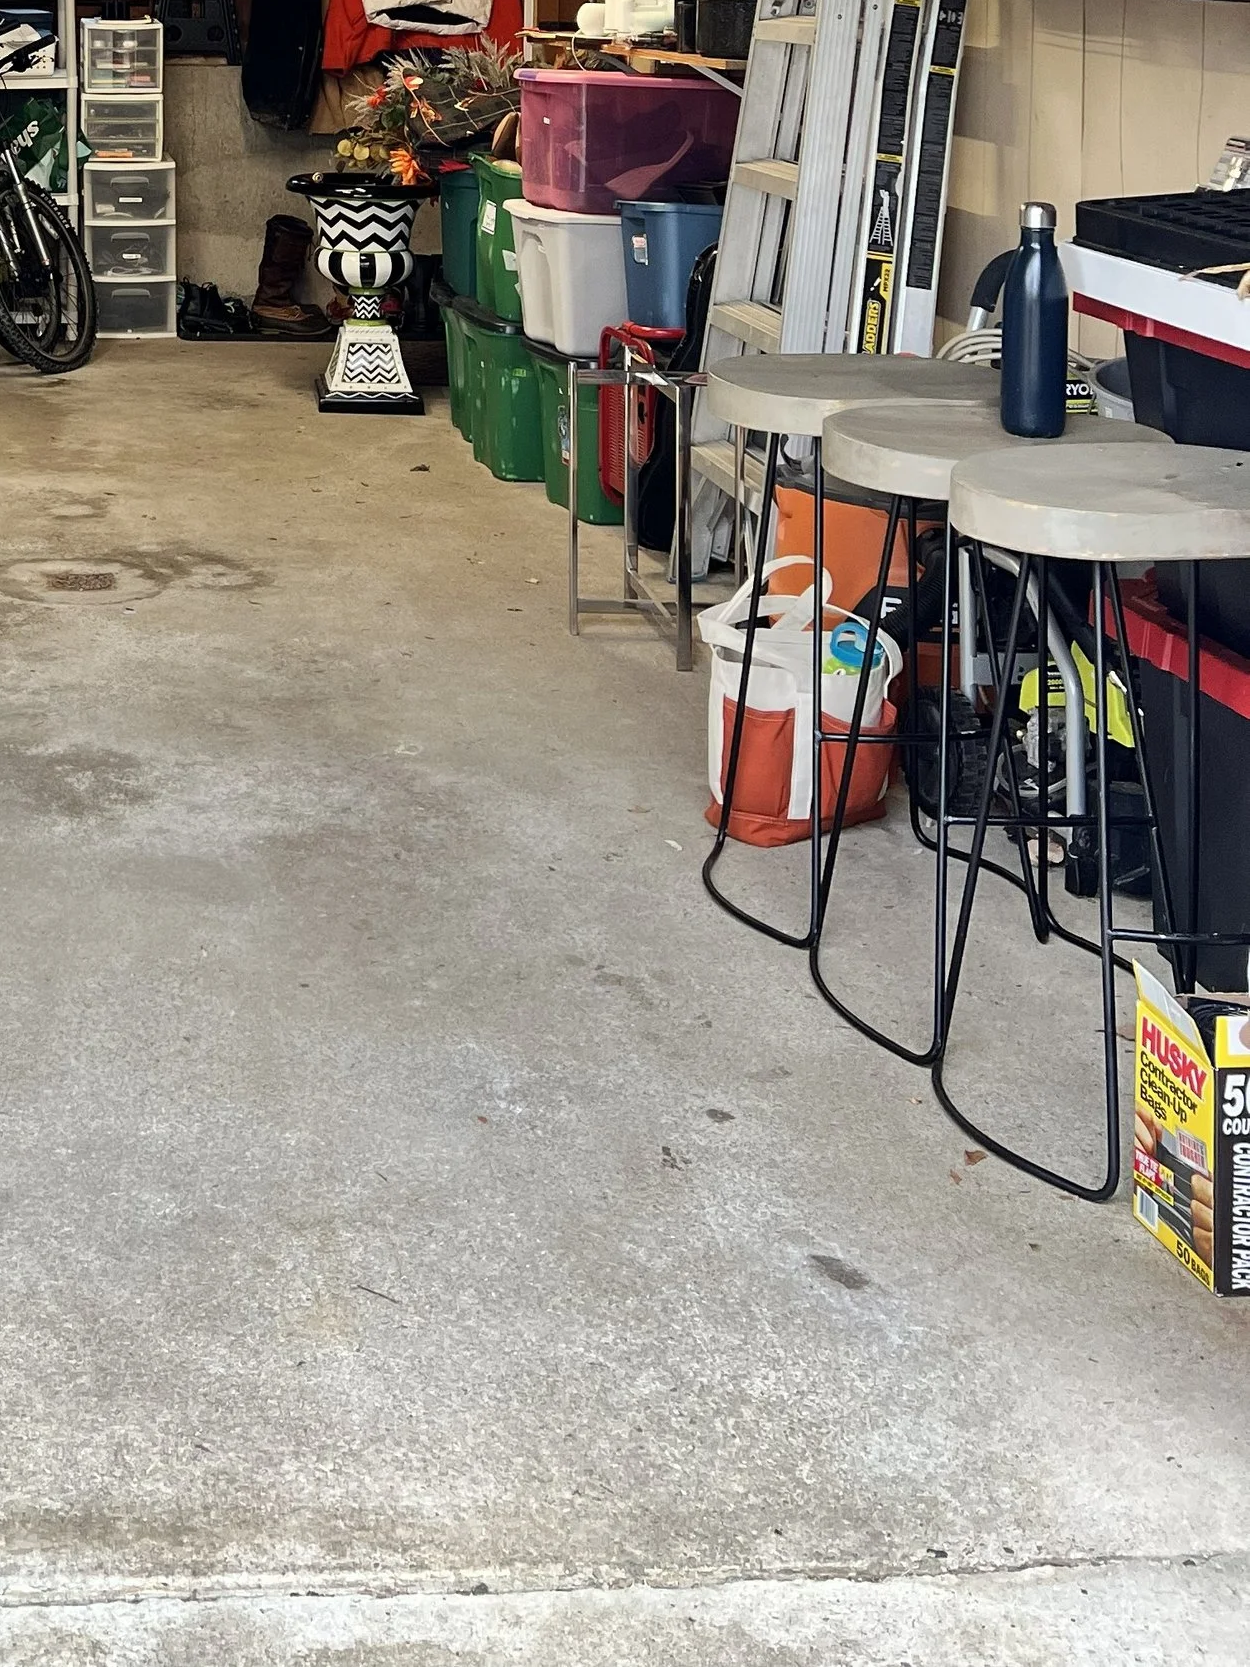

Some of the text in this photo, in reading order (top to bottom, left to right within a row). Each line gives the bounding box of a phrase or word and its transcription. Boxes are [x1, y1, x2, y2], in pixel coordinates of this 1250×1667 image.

[862, 301, 880, 354] ADDERS
[1140, 1050, 1198, 1114] Contractor
[1141, 1016, 1207, 1100] HUSKY
[1140, 1067, 1188, 1124] Clean-Up
[1140, 1083, 1167, 1121] Bags
[1222, 1074, 1250, 1117] 5
[1231, 1142, 1250, 1290] CONTRACTOR PACK
[1176, 1239, 1190, 1265] 50
